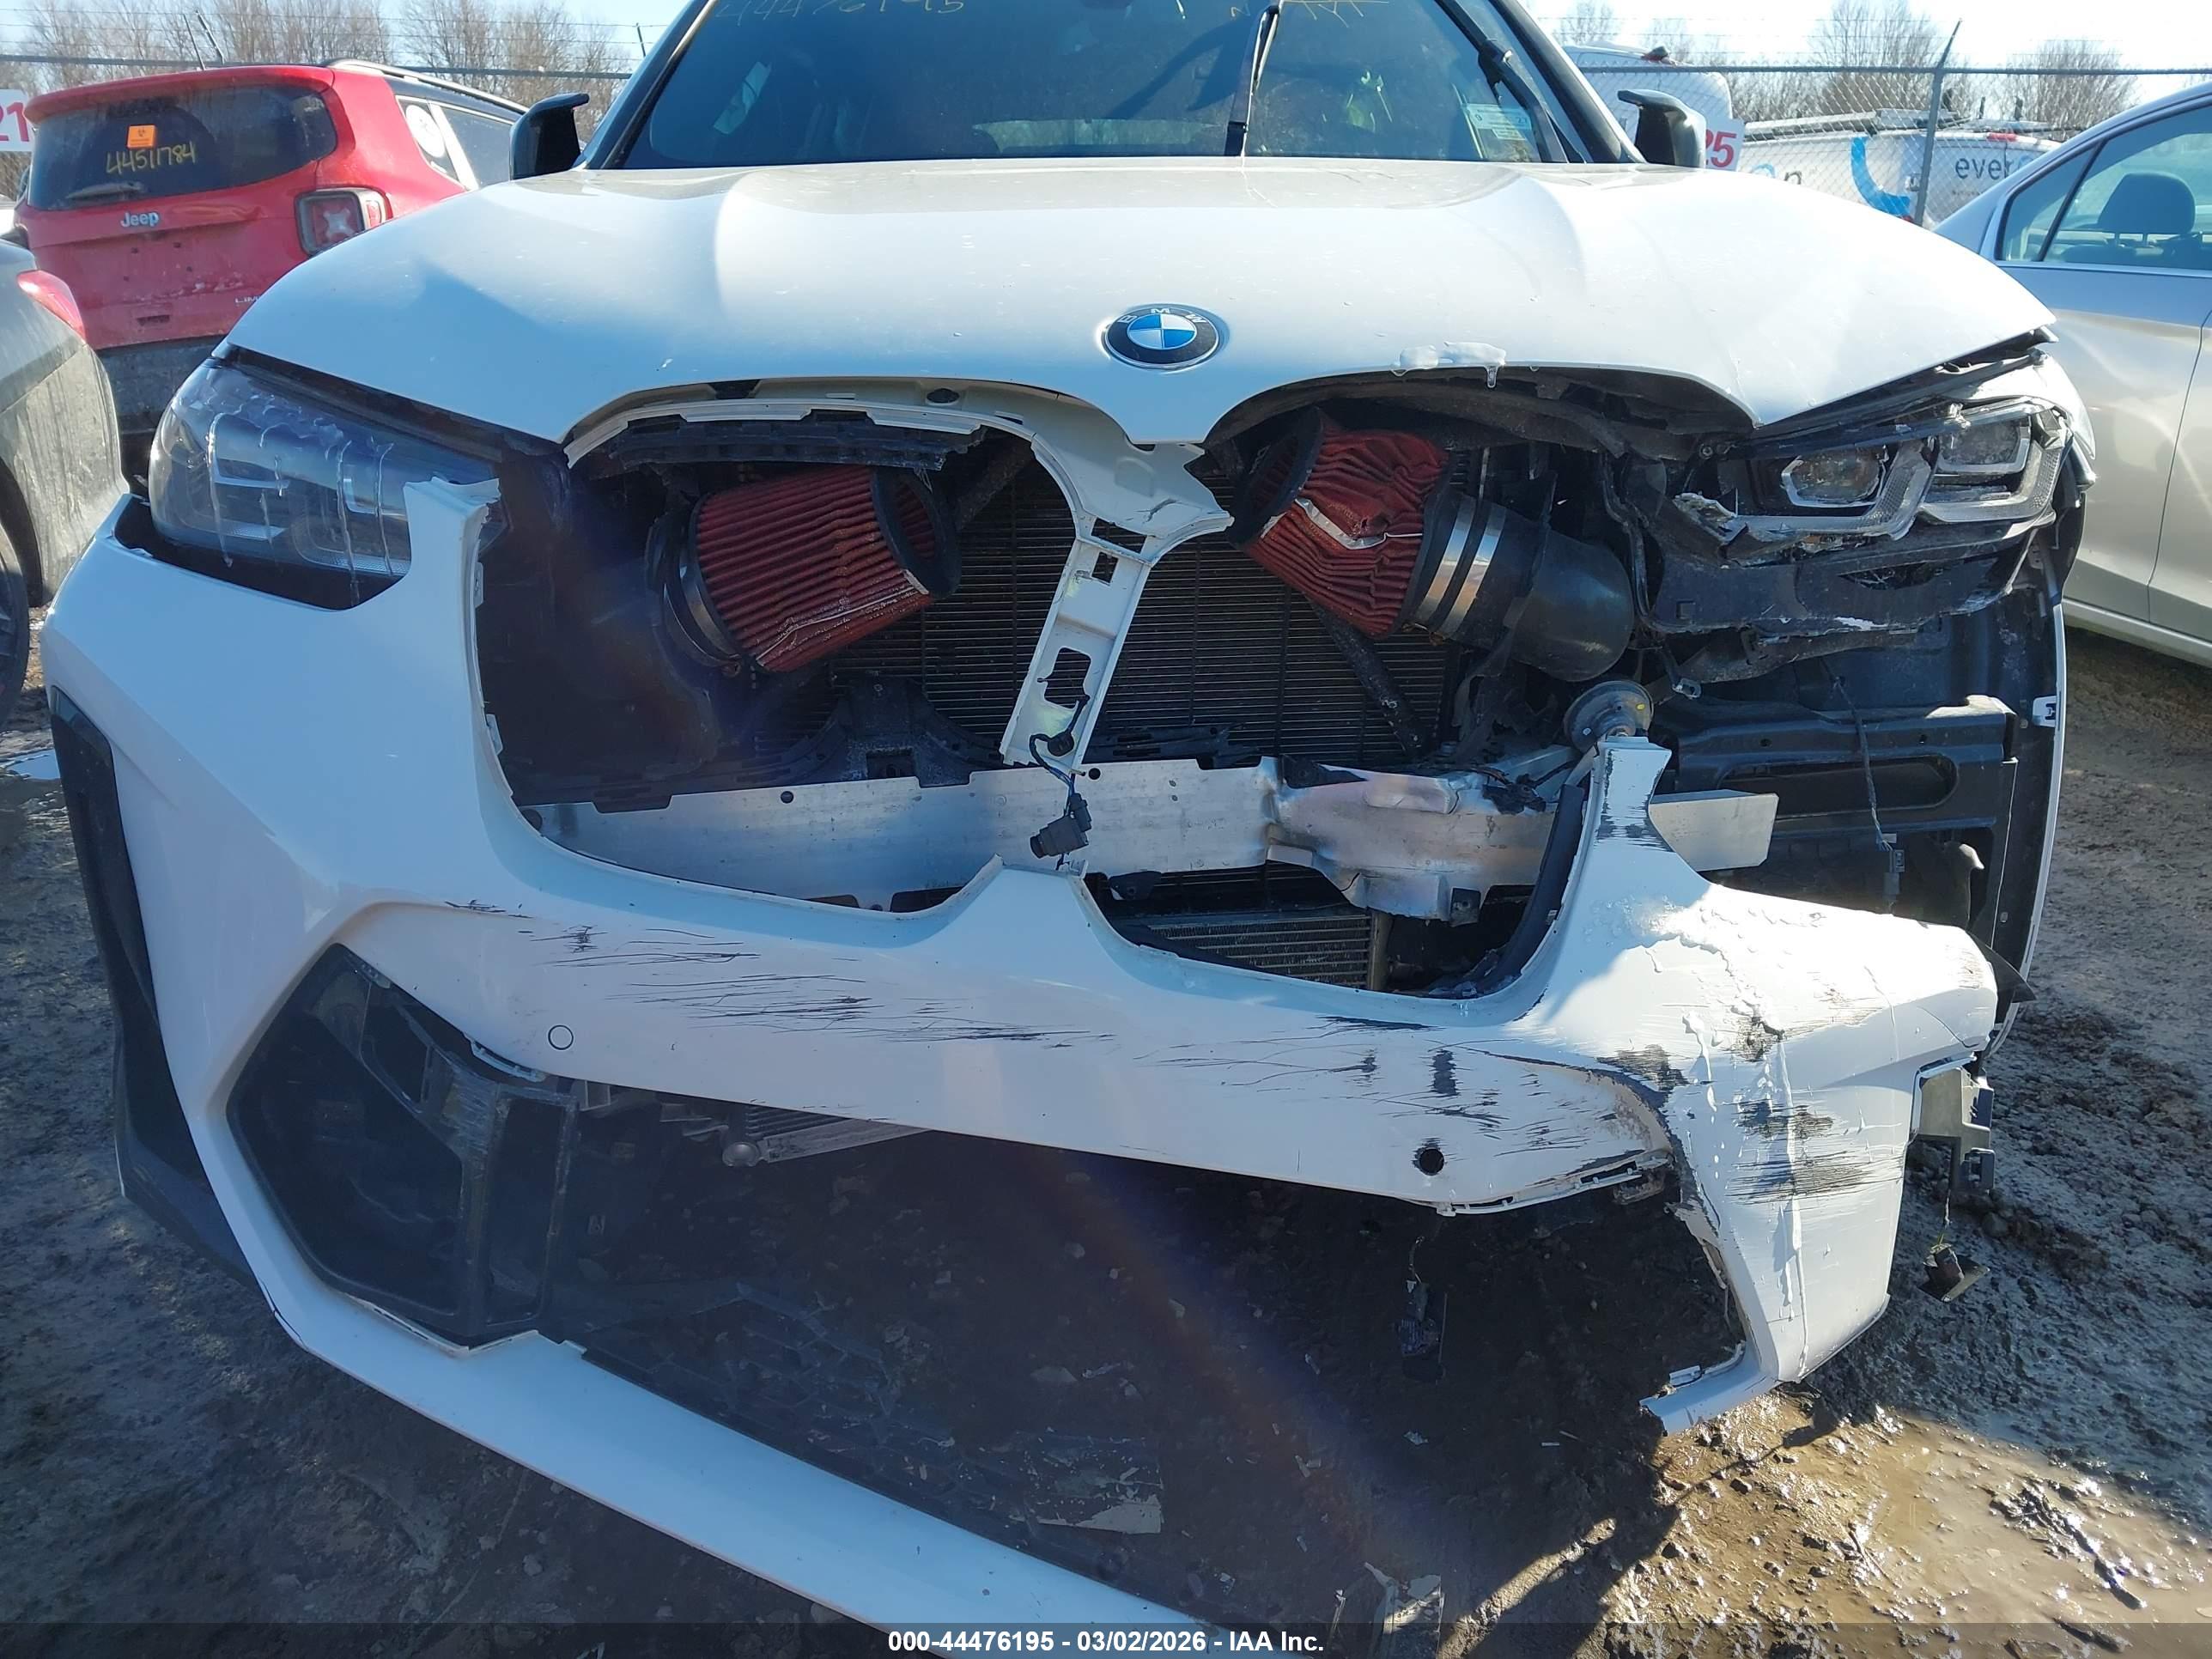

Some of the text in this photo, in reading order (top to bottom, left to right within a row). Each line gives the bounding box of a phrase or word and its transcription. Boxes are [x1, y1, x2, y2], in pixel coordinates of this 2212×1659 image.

[106, 140, 196, 174] 44511784
[121, 212, 159, 228] Jeep
[1116, 307, 1206, 324] BMW
